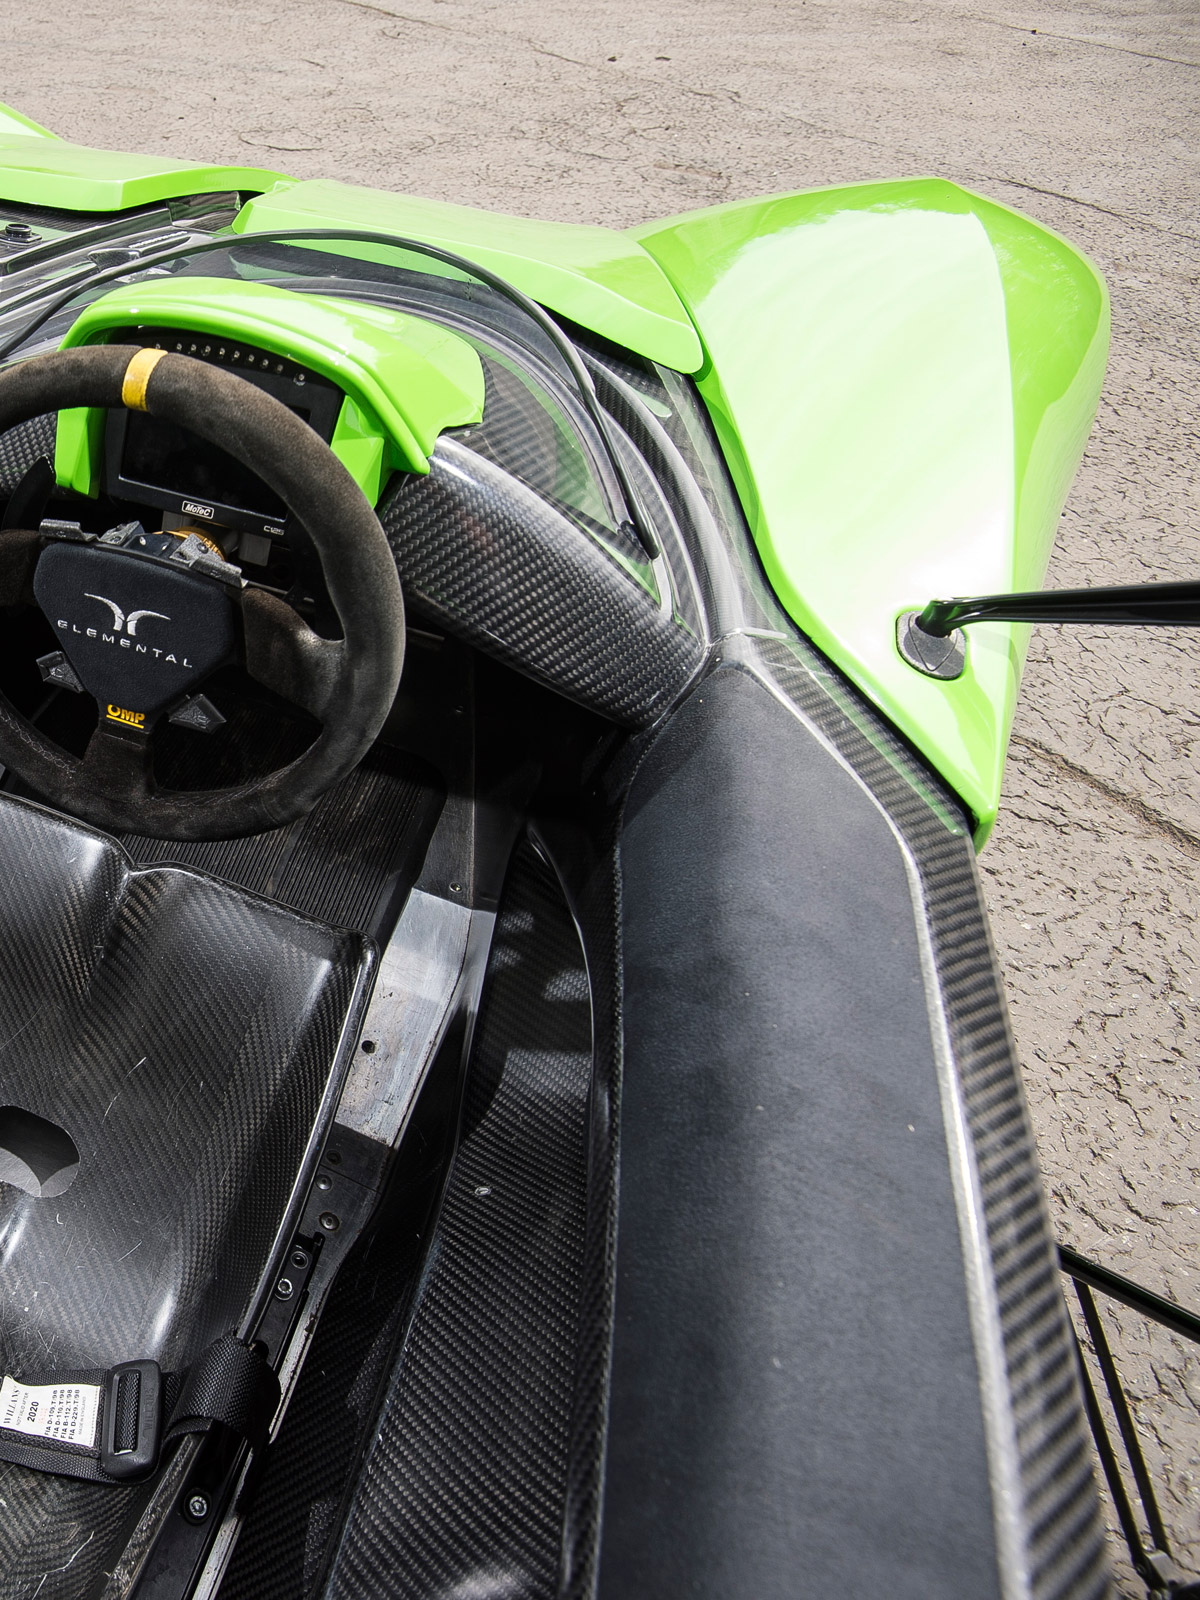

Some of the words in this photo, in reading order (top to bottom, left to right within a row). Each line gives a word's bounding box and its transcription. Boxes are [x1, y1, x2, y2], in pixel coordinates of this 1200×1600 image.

[185, 504, 211, 516] MoTeC
[263, 525, 284, 536] C125
[57, 619, 192, 668] ELEMENTAL
[107, 704, 145, 723] OMP
[3, 1388, 20, 1423] WILLANS
[27, 1400, 39, 1422] 2020
